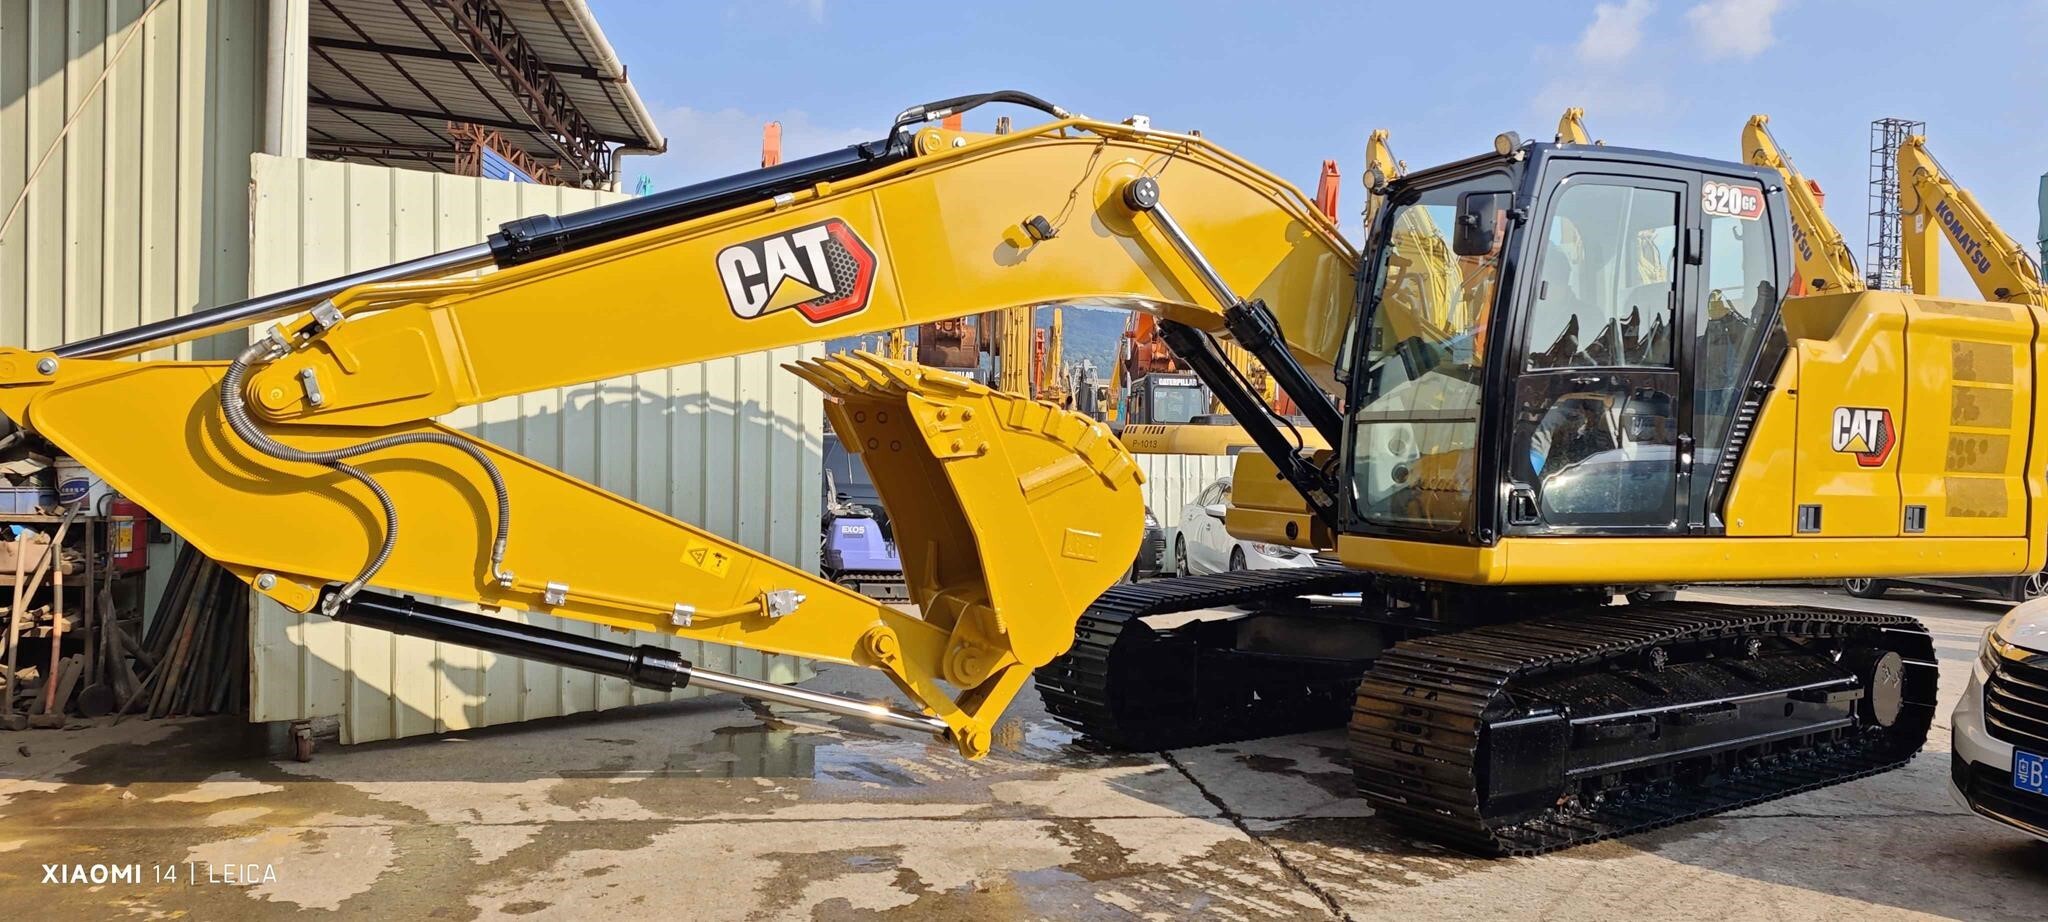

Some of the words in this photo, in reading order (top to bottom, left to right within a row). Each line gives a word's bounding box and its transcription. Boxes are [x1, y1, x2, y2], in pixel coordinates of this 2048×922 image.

[1935, 199, 1992, 274] KOMATSU
[718, 225, 836, 318] CAT
[1158, 378, 1198, 387] CATERPILLAR
[1132, 439, 1158, 449] P-1013
[1833, 407, 1883, 453] CAT
